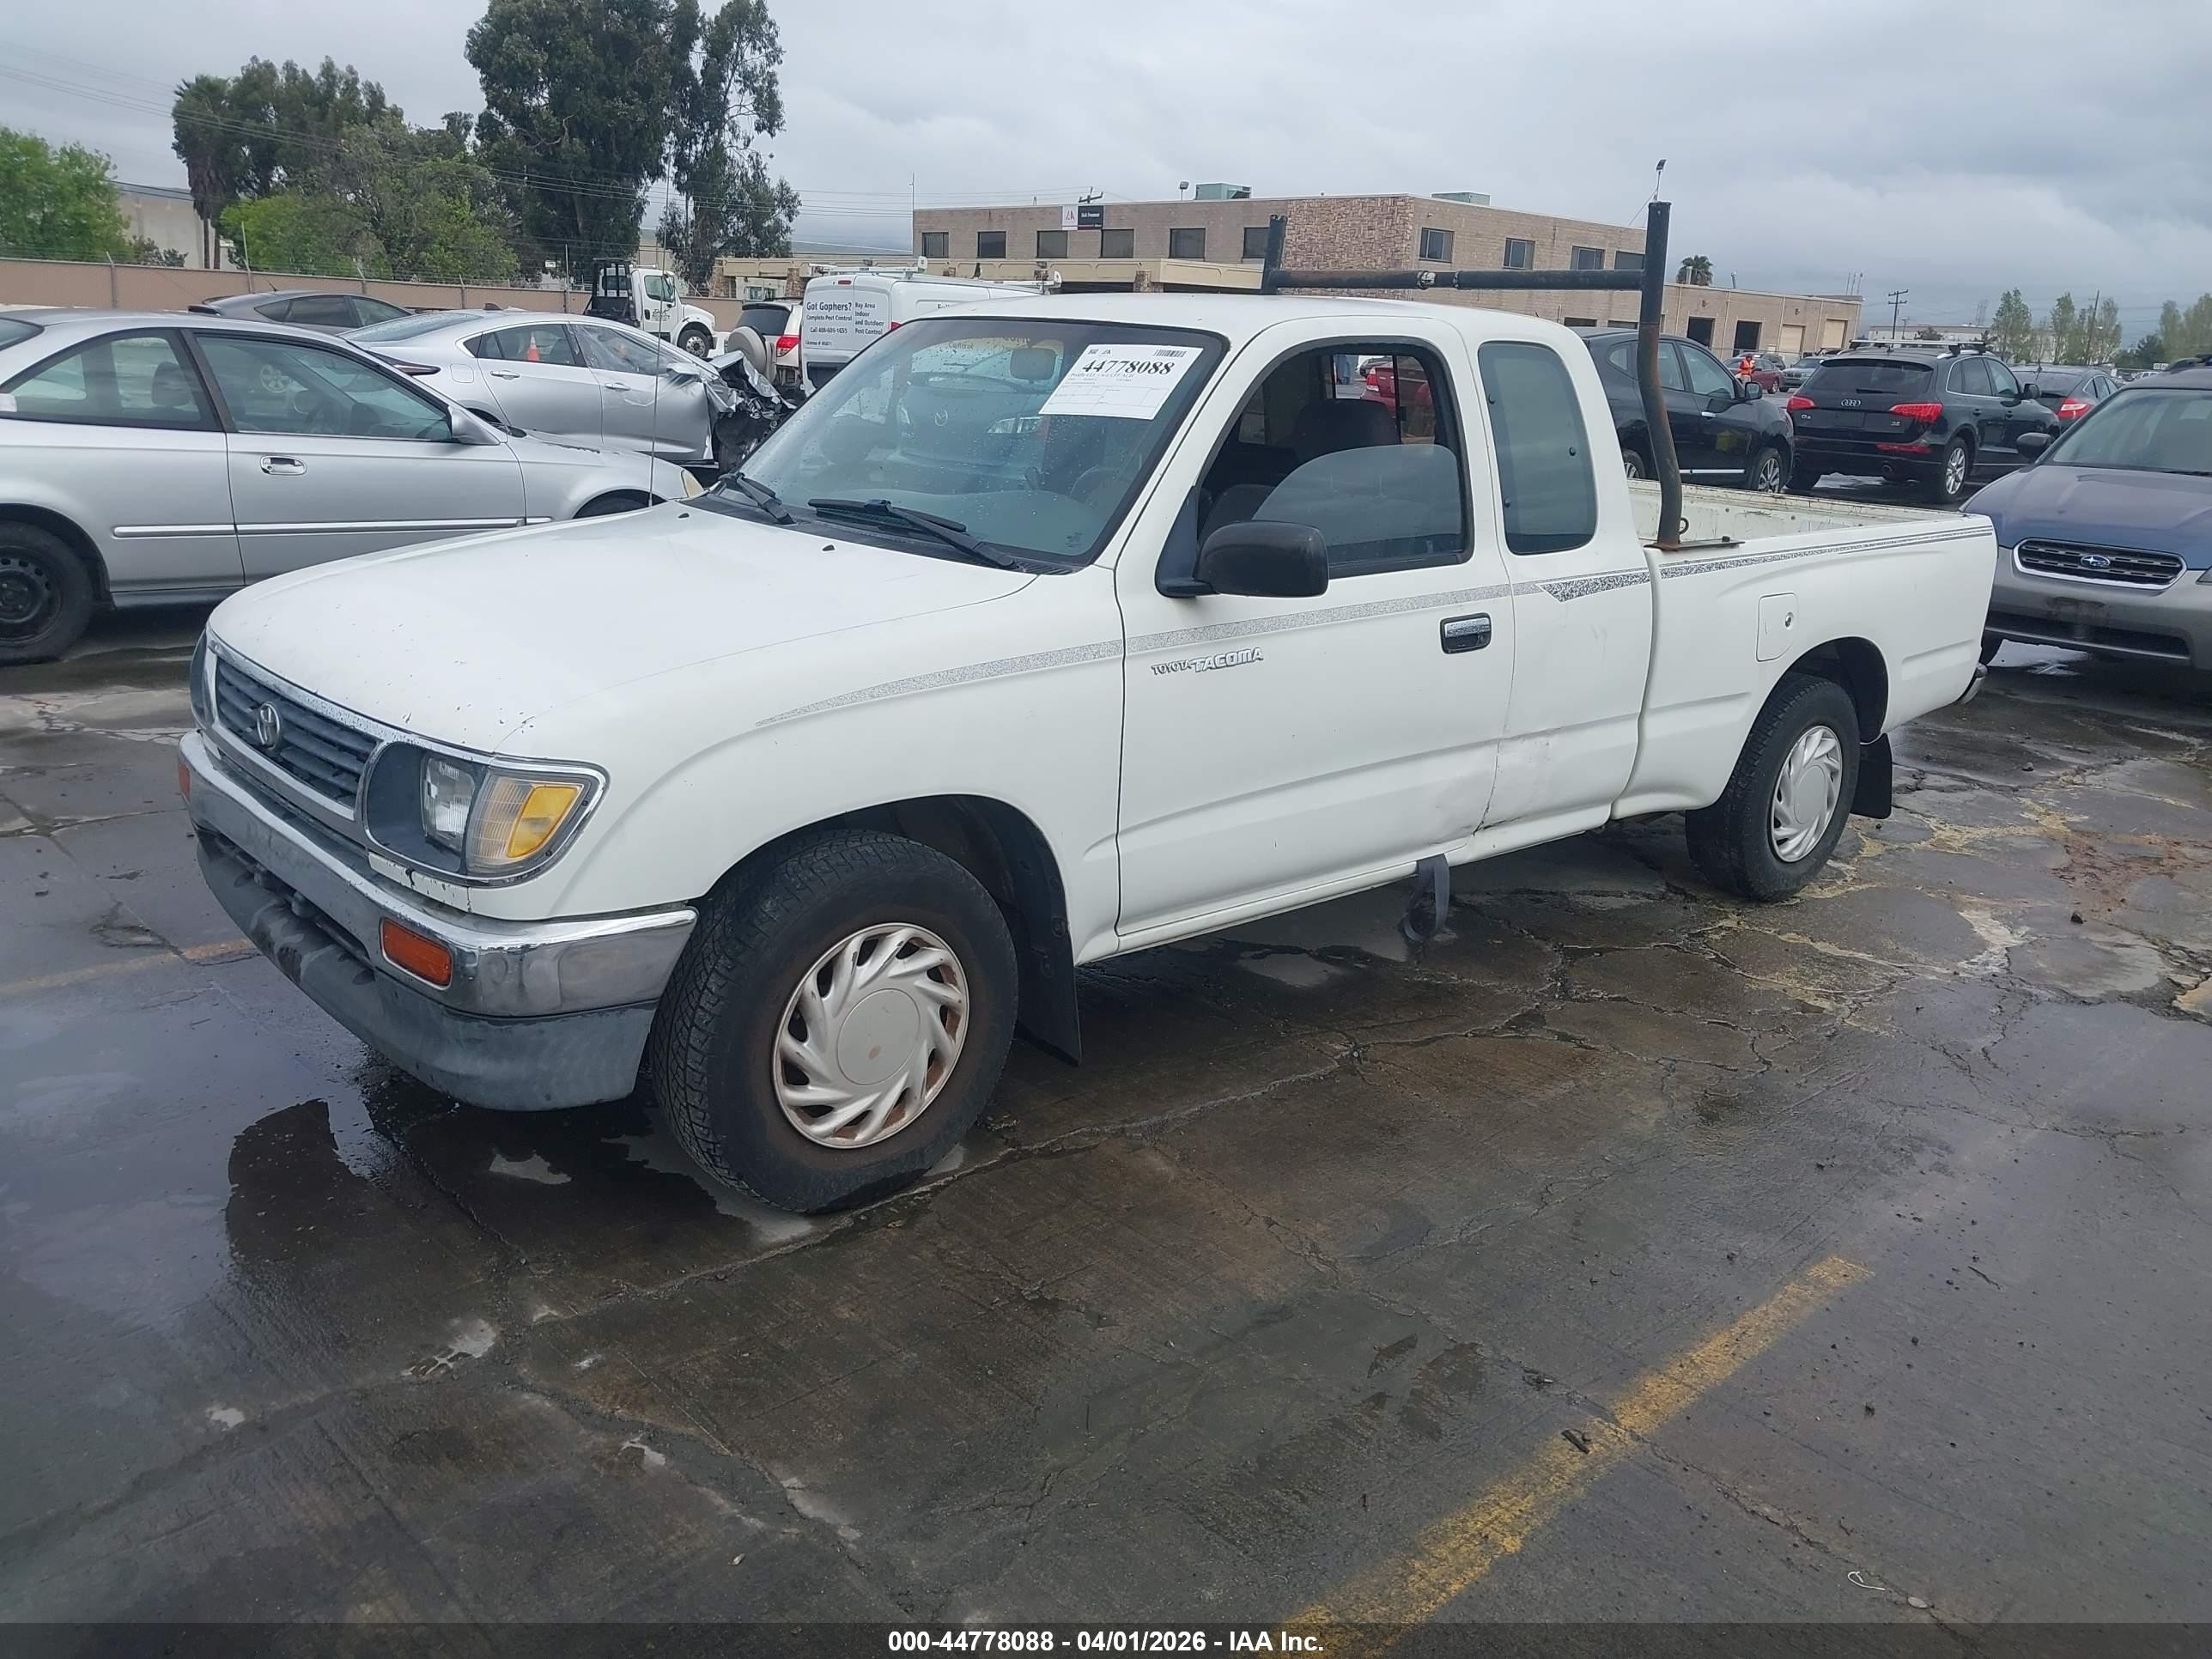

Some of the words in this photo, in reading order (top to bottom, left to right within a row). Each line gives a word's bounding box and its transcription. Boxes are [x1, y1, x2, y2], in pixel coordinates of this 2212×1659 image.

[806, 301, 817, 311] Got
[819, 301, 852, 313] Gophers?
[854, 301, 863, 310] Bay
[1082, 359, 1175, 375] 44778088
[1151, 659, 1192, 676] TOYOTA
[1189, 647, 1264, 673] TACOMA
